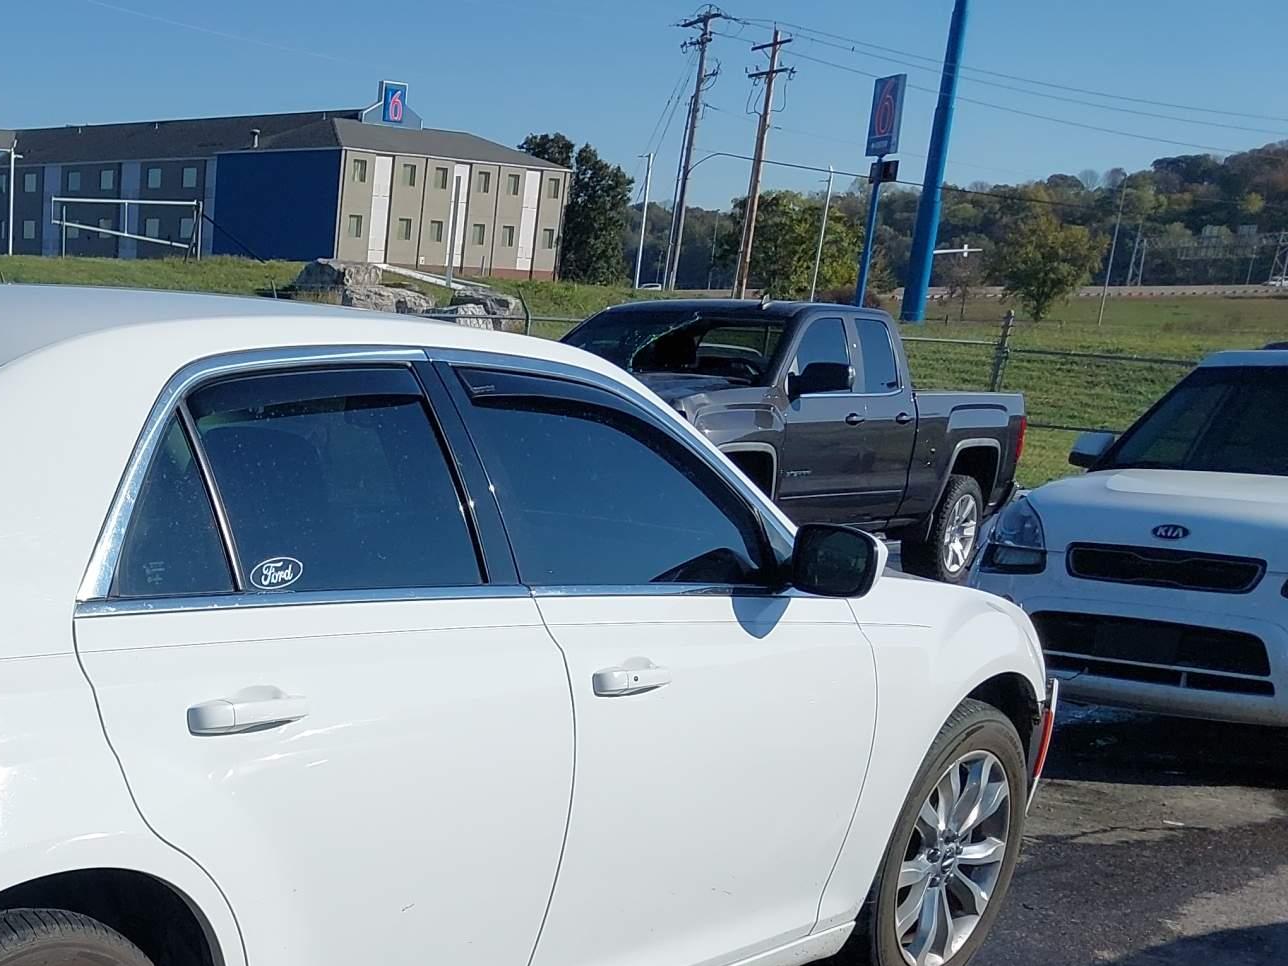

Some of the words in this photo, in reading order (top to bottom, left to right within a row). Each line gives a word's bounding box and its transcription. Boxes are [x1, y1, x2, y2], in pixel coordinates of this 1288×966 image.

[389, 90, 403, 121] 6
[875, 79, 896, 137] 6
[1156, 526, 1183, 538] KIA
[261, 561, 294, 586] Ford
